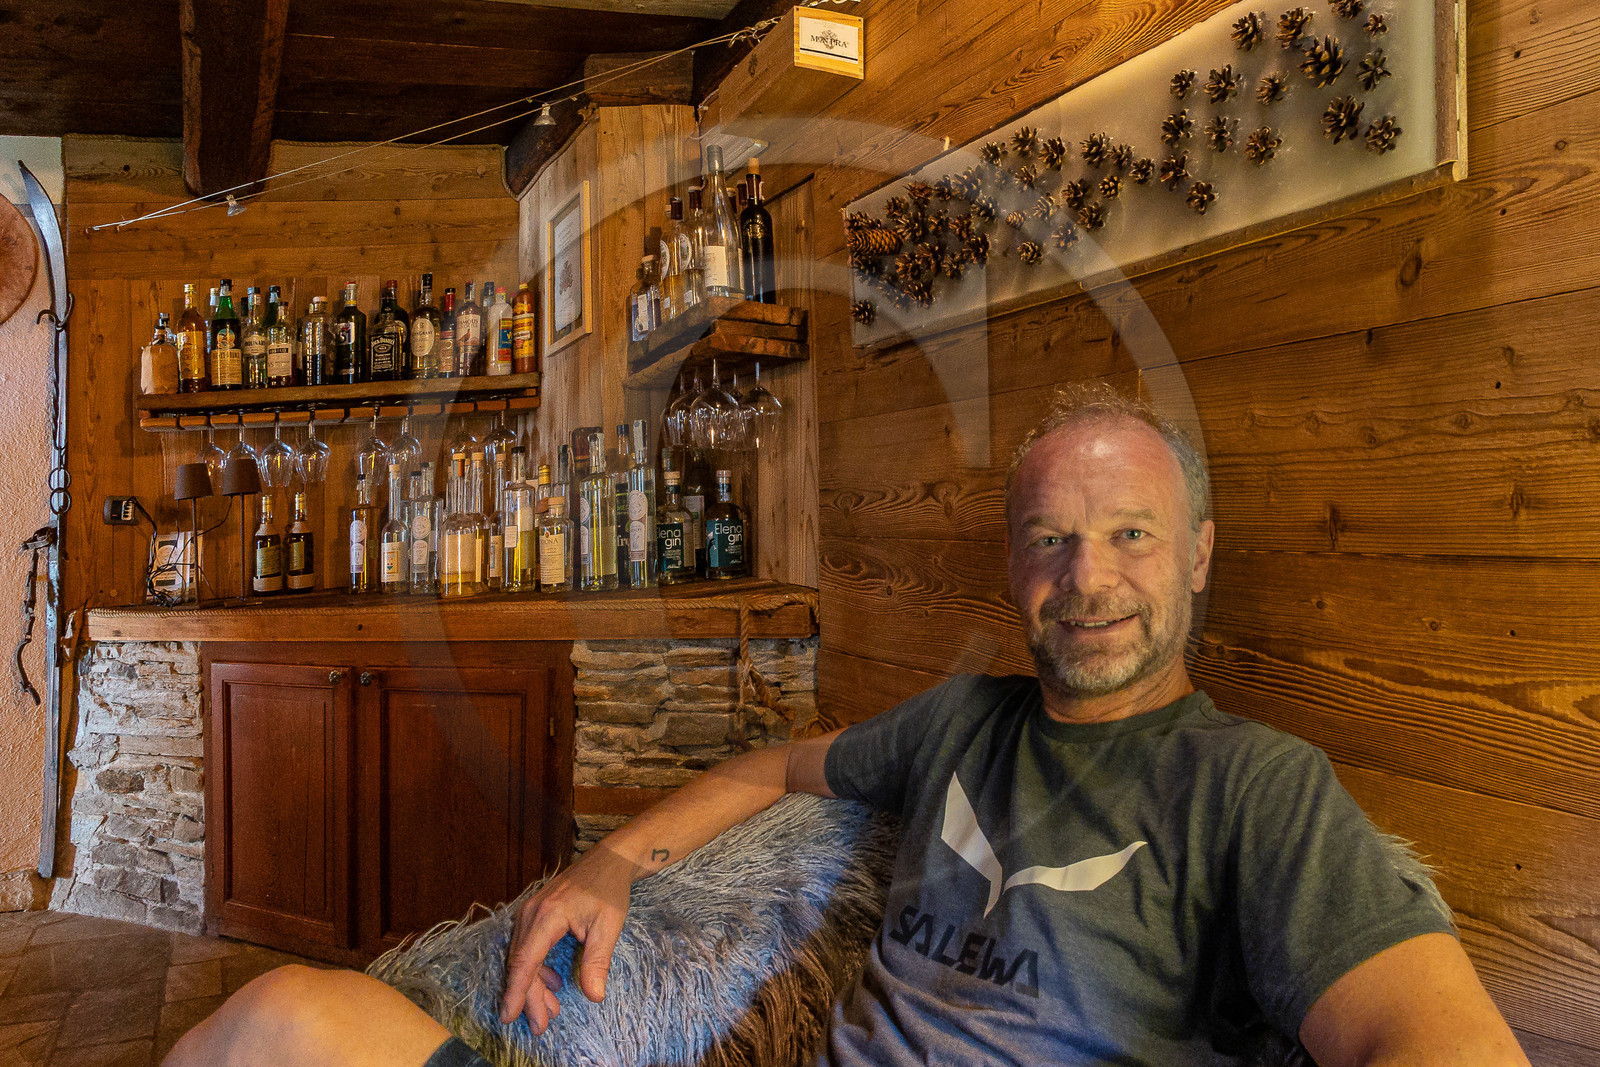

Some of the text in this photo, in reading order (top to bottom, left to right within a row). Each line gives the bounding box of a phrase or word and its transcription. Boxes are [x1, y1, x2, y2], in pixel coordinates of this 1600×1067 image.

[714, 523, 742, 535] Elena
[664, 538, 682, 549] gin
[727, 533, 743, 545] gin
[889, 904, 1040, 999] SALEWA
